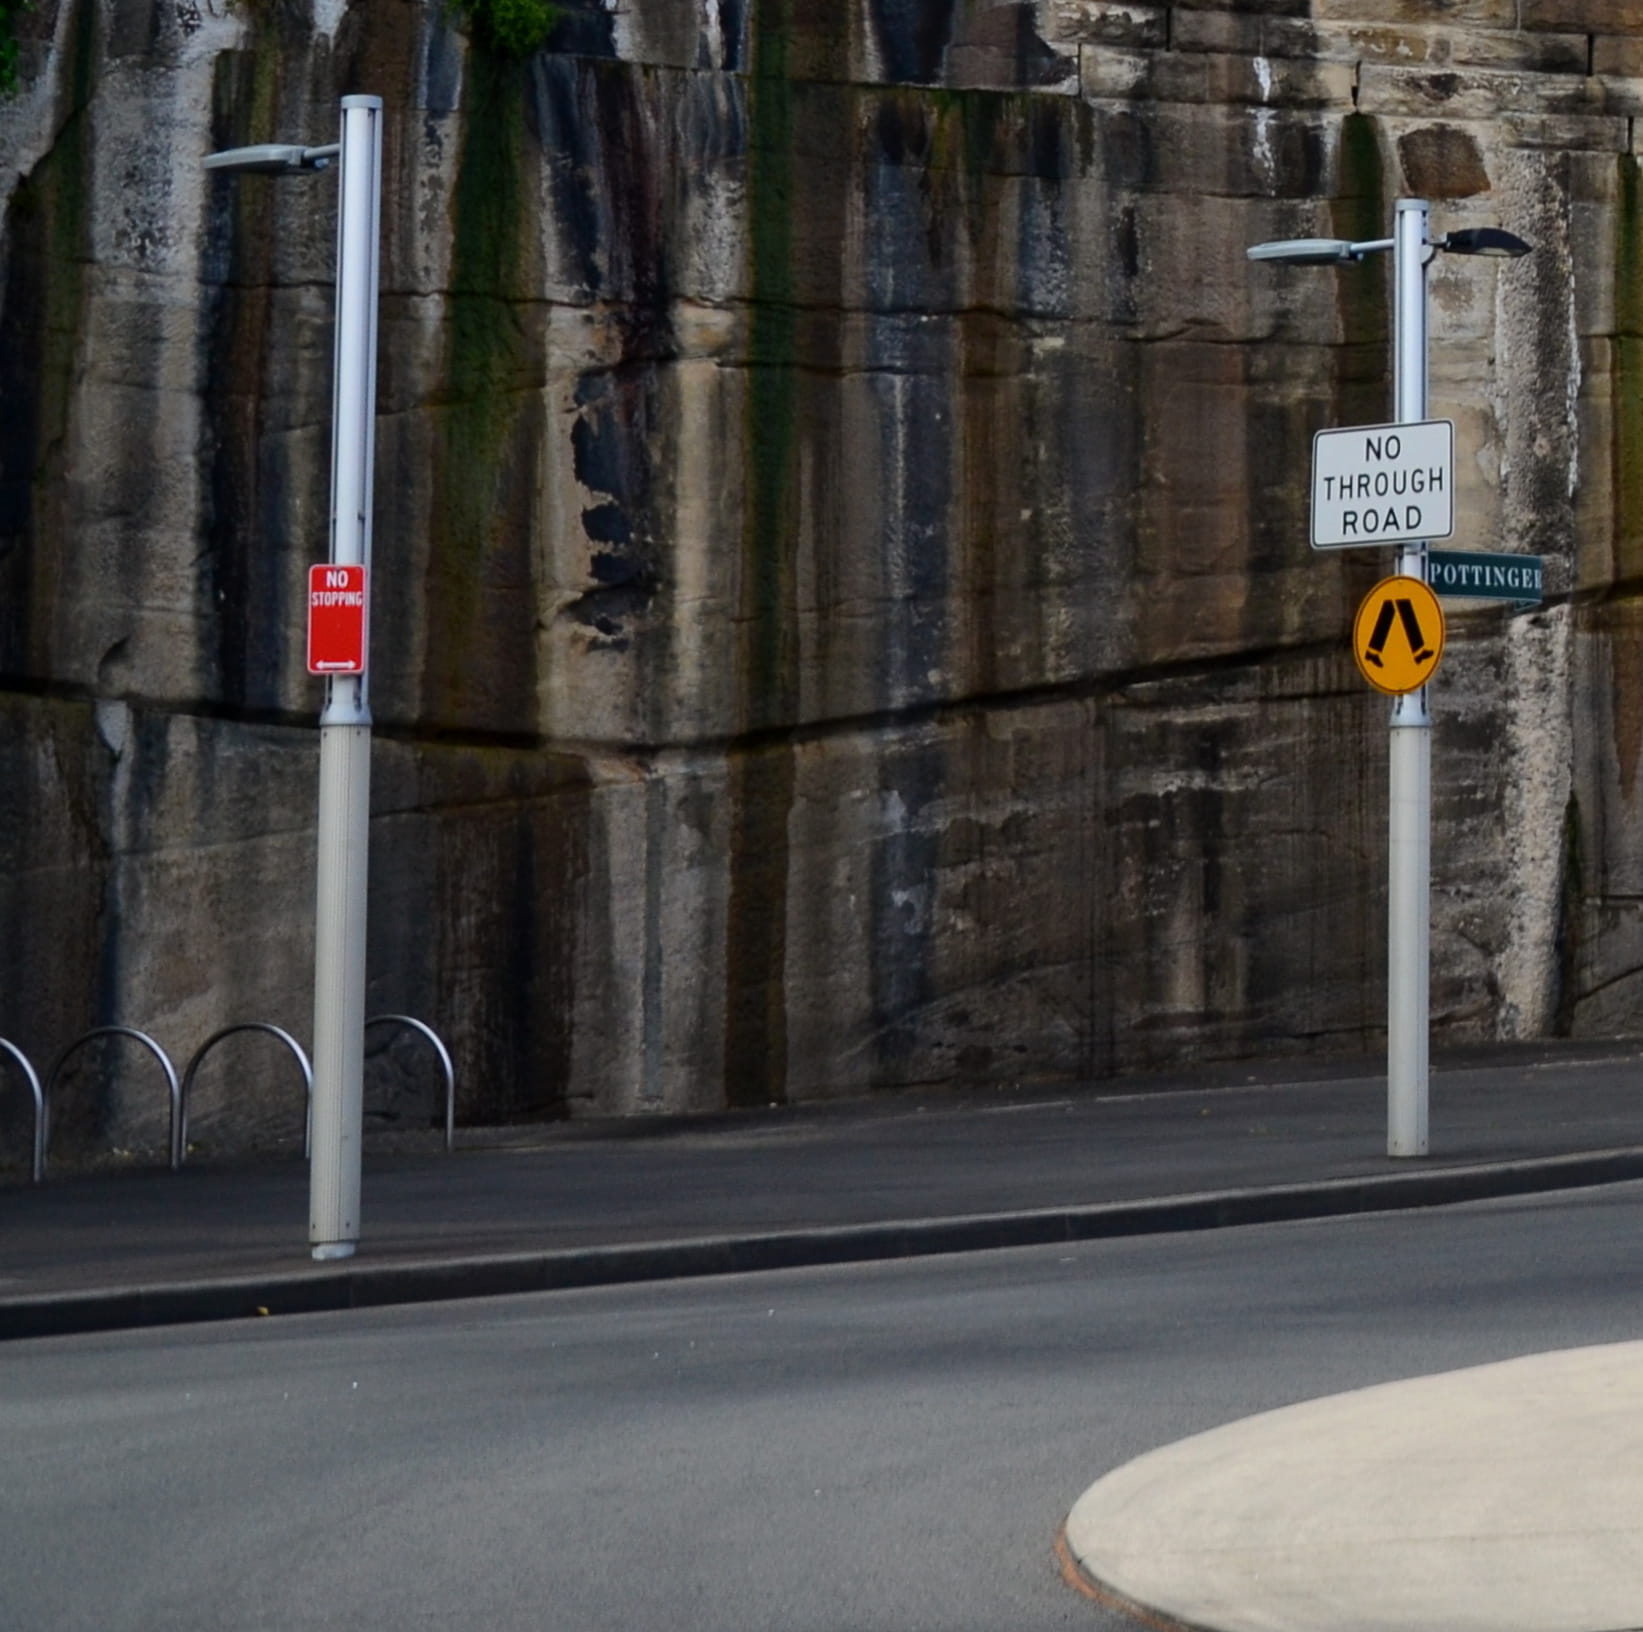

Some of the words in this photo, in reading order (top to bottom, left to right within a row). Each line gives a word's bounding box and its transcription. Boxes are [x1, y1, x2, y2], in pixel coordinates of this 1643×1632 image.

[1366, 435, 1401, 462] NO
[1324, 467, 1444, 501] THROUGH
[1343, 506, 1422, 535] ROAD
[326, 570, 349, 588] NO
[312, 591, 363, 607] STOPPING
